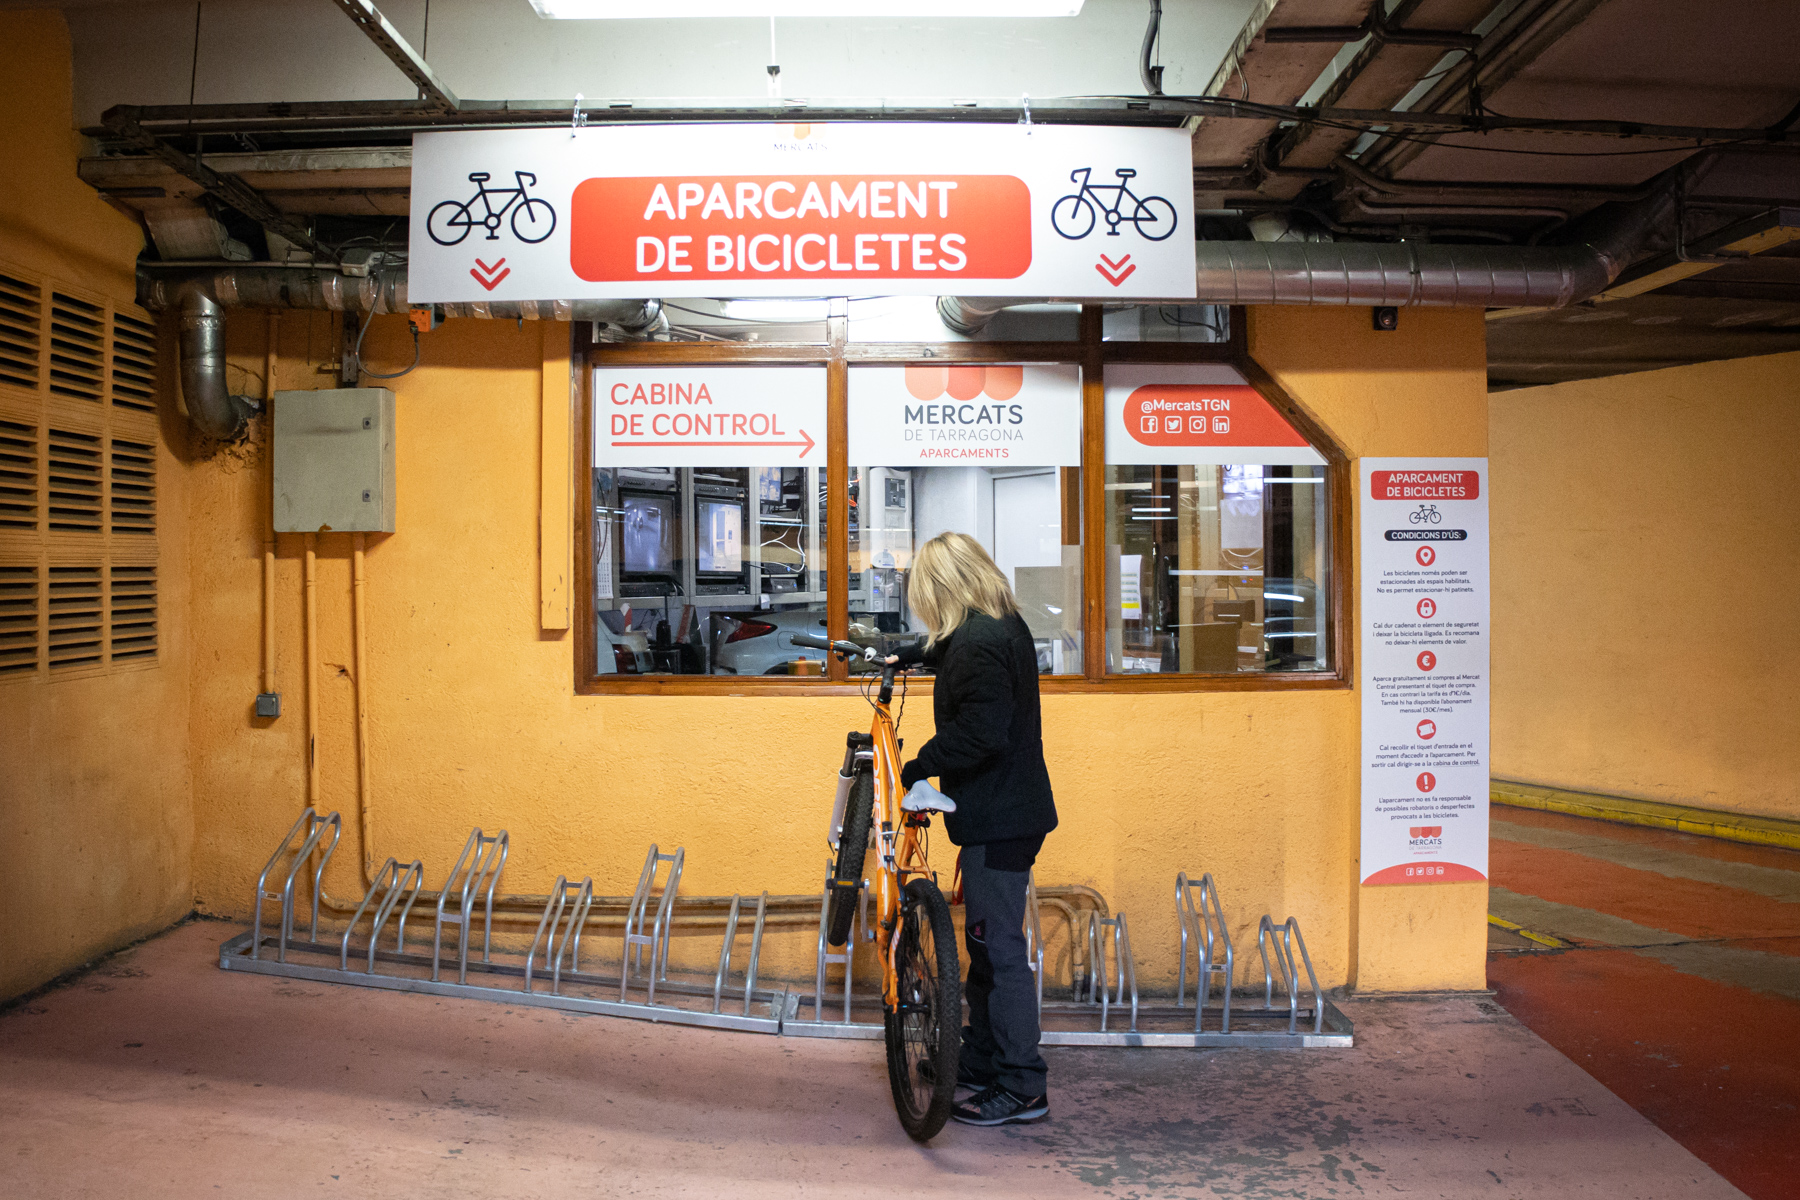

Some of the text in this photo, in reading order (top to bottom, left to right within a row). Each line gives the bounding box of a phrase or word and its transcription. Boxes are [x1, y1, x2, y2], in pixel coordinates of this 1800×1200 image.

[644, 181, 958, 220] APARCAMENT
[636, 234, 967, 272] DE BICICLETES
[611, 383, 712, 405] CABINA
[1141, 399, 1230, 413] @MercatsTGN
[905, 405, 1022, 424] MERCATS
[611, 413, 785, 436] DE CONTROL
[905, 429, 1024, 441] DE TARRAGONA
[920, 448, 1008, 458] APARCAMENTS
[1389, 473, 1463, 483] APARCAMENT
[1387, 487, 1465, 496] DE BICICLETES
